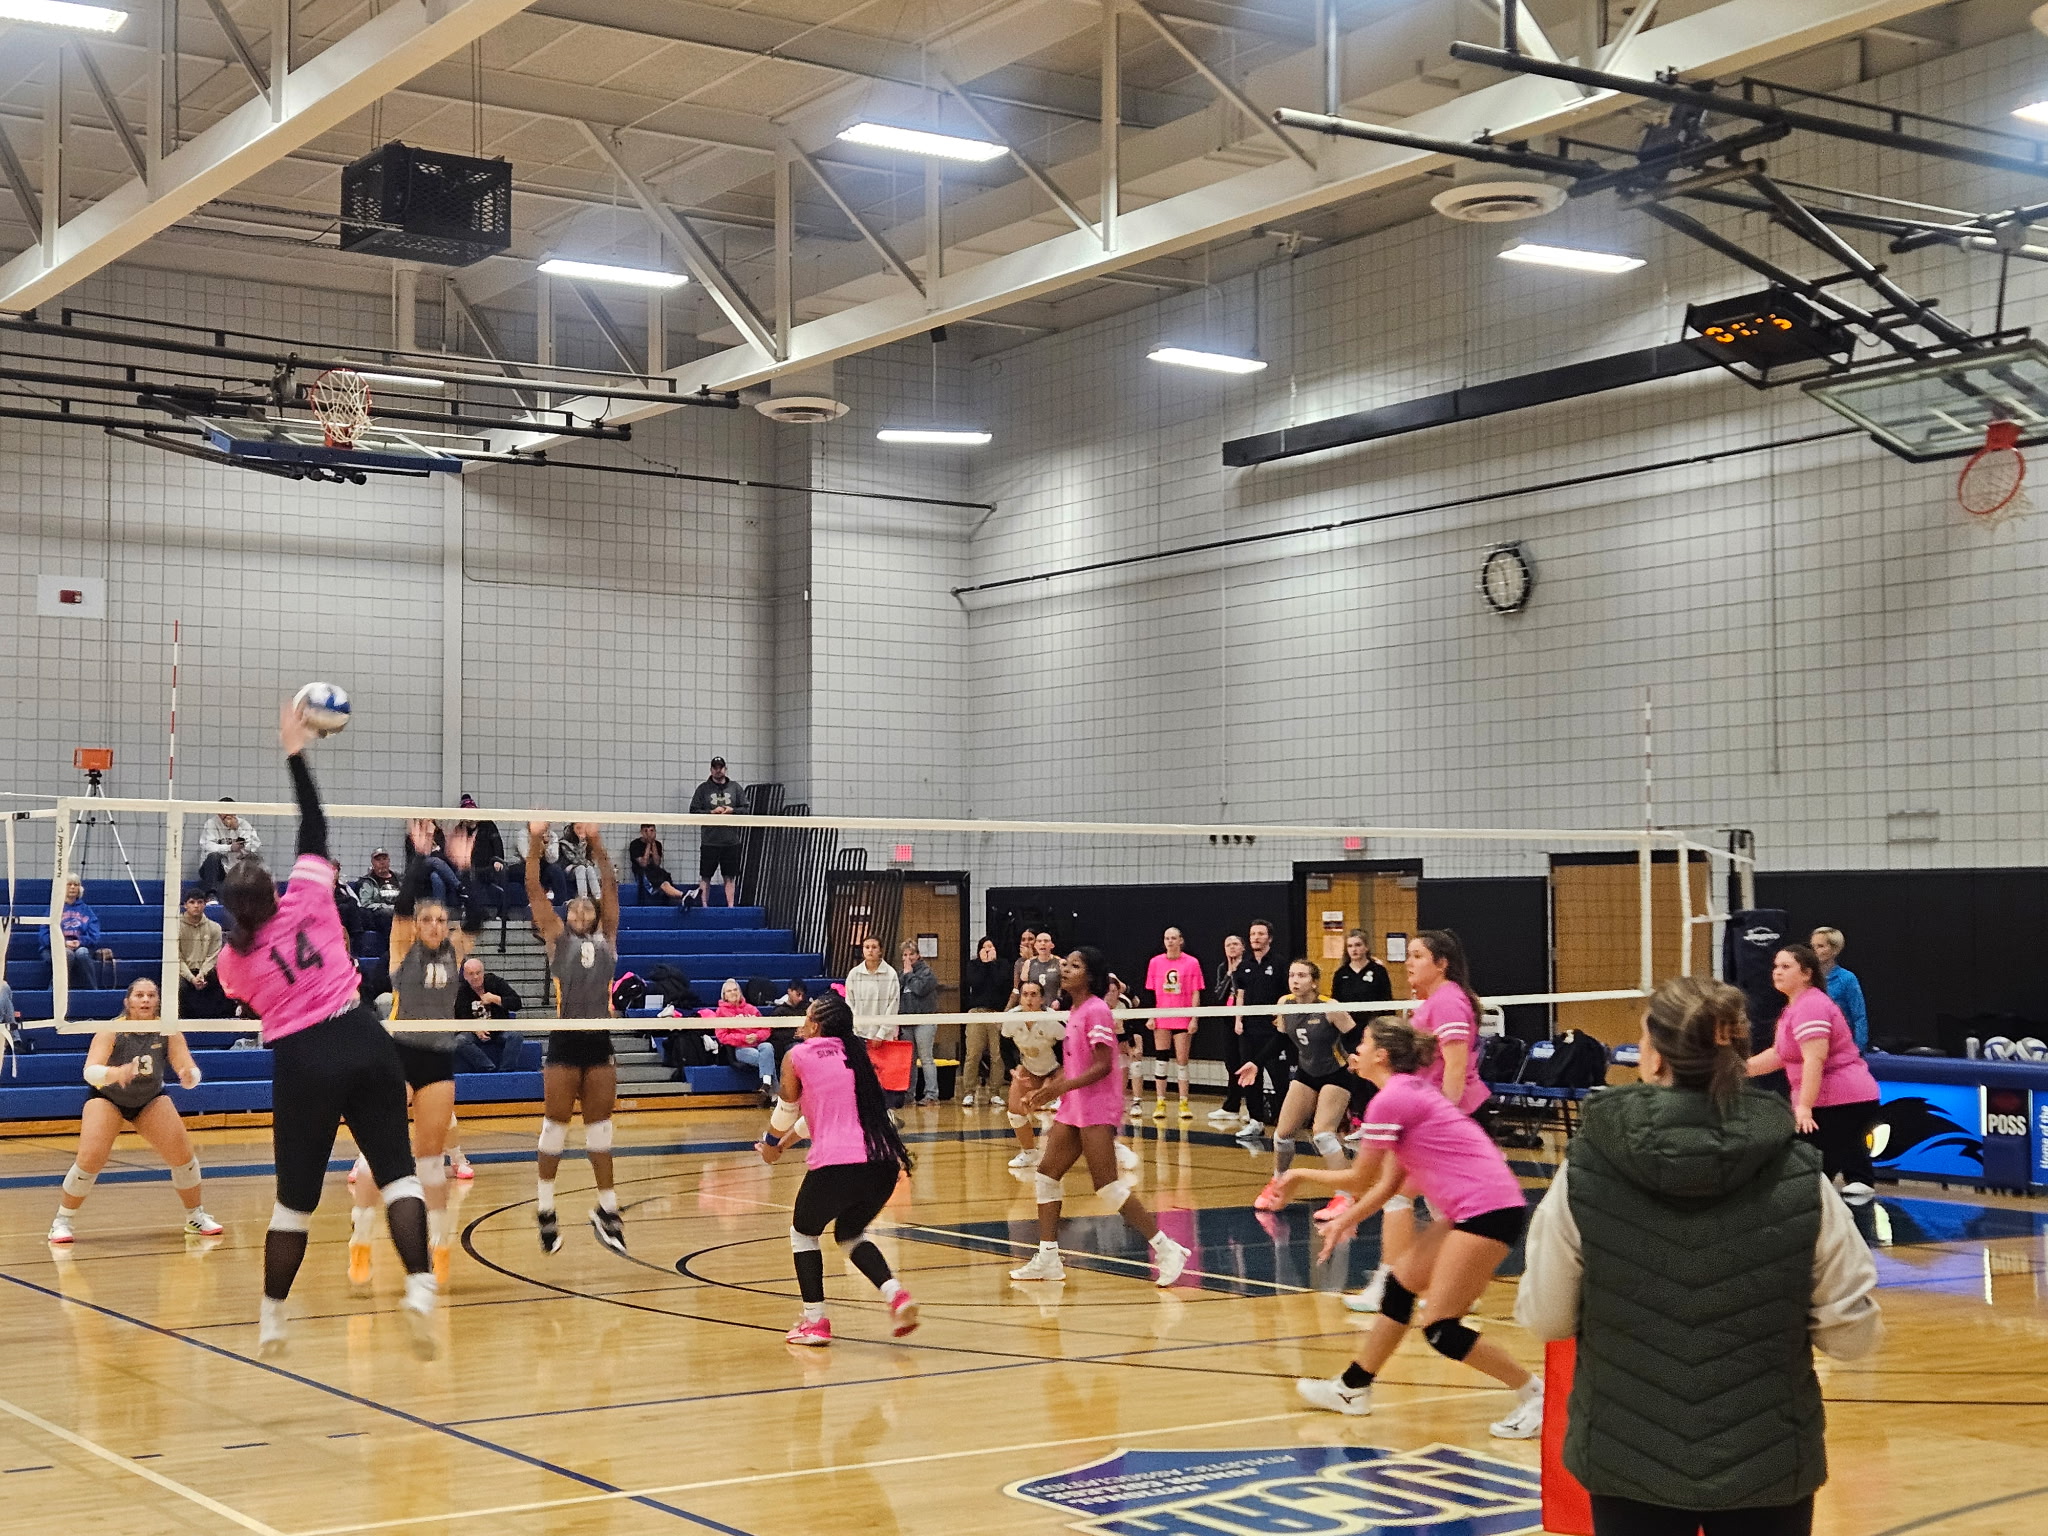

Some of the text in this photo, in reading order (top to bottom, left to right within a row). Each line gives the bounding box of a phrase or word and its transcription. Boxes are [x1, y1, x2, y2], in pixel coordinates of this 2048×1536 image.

[269, 931, 324, 985] 14
[1295, 1028, 1309, 1046] 5
[816, 1049, 840, 1059] SUNY
[1987, 1113, 2027, 1136] POSS
[1069, 1483, 1209, 1505] NATIONAL
